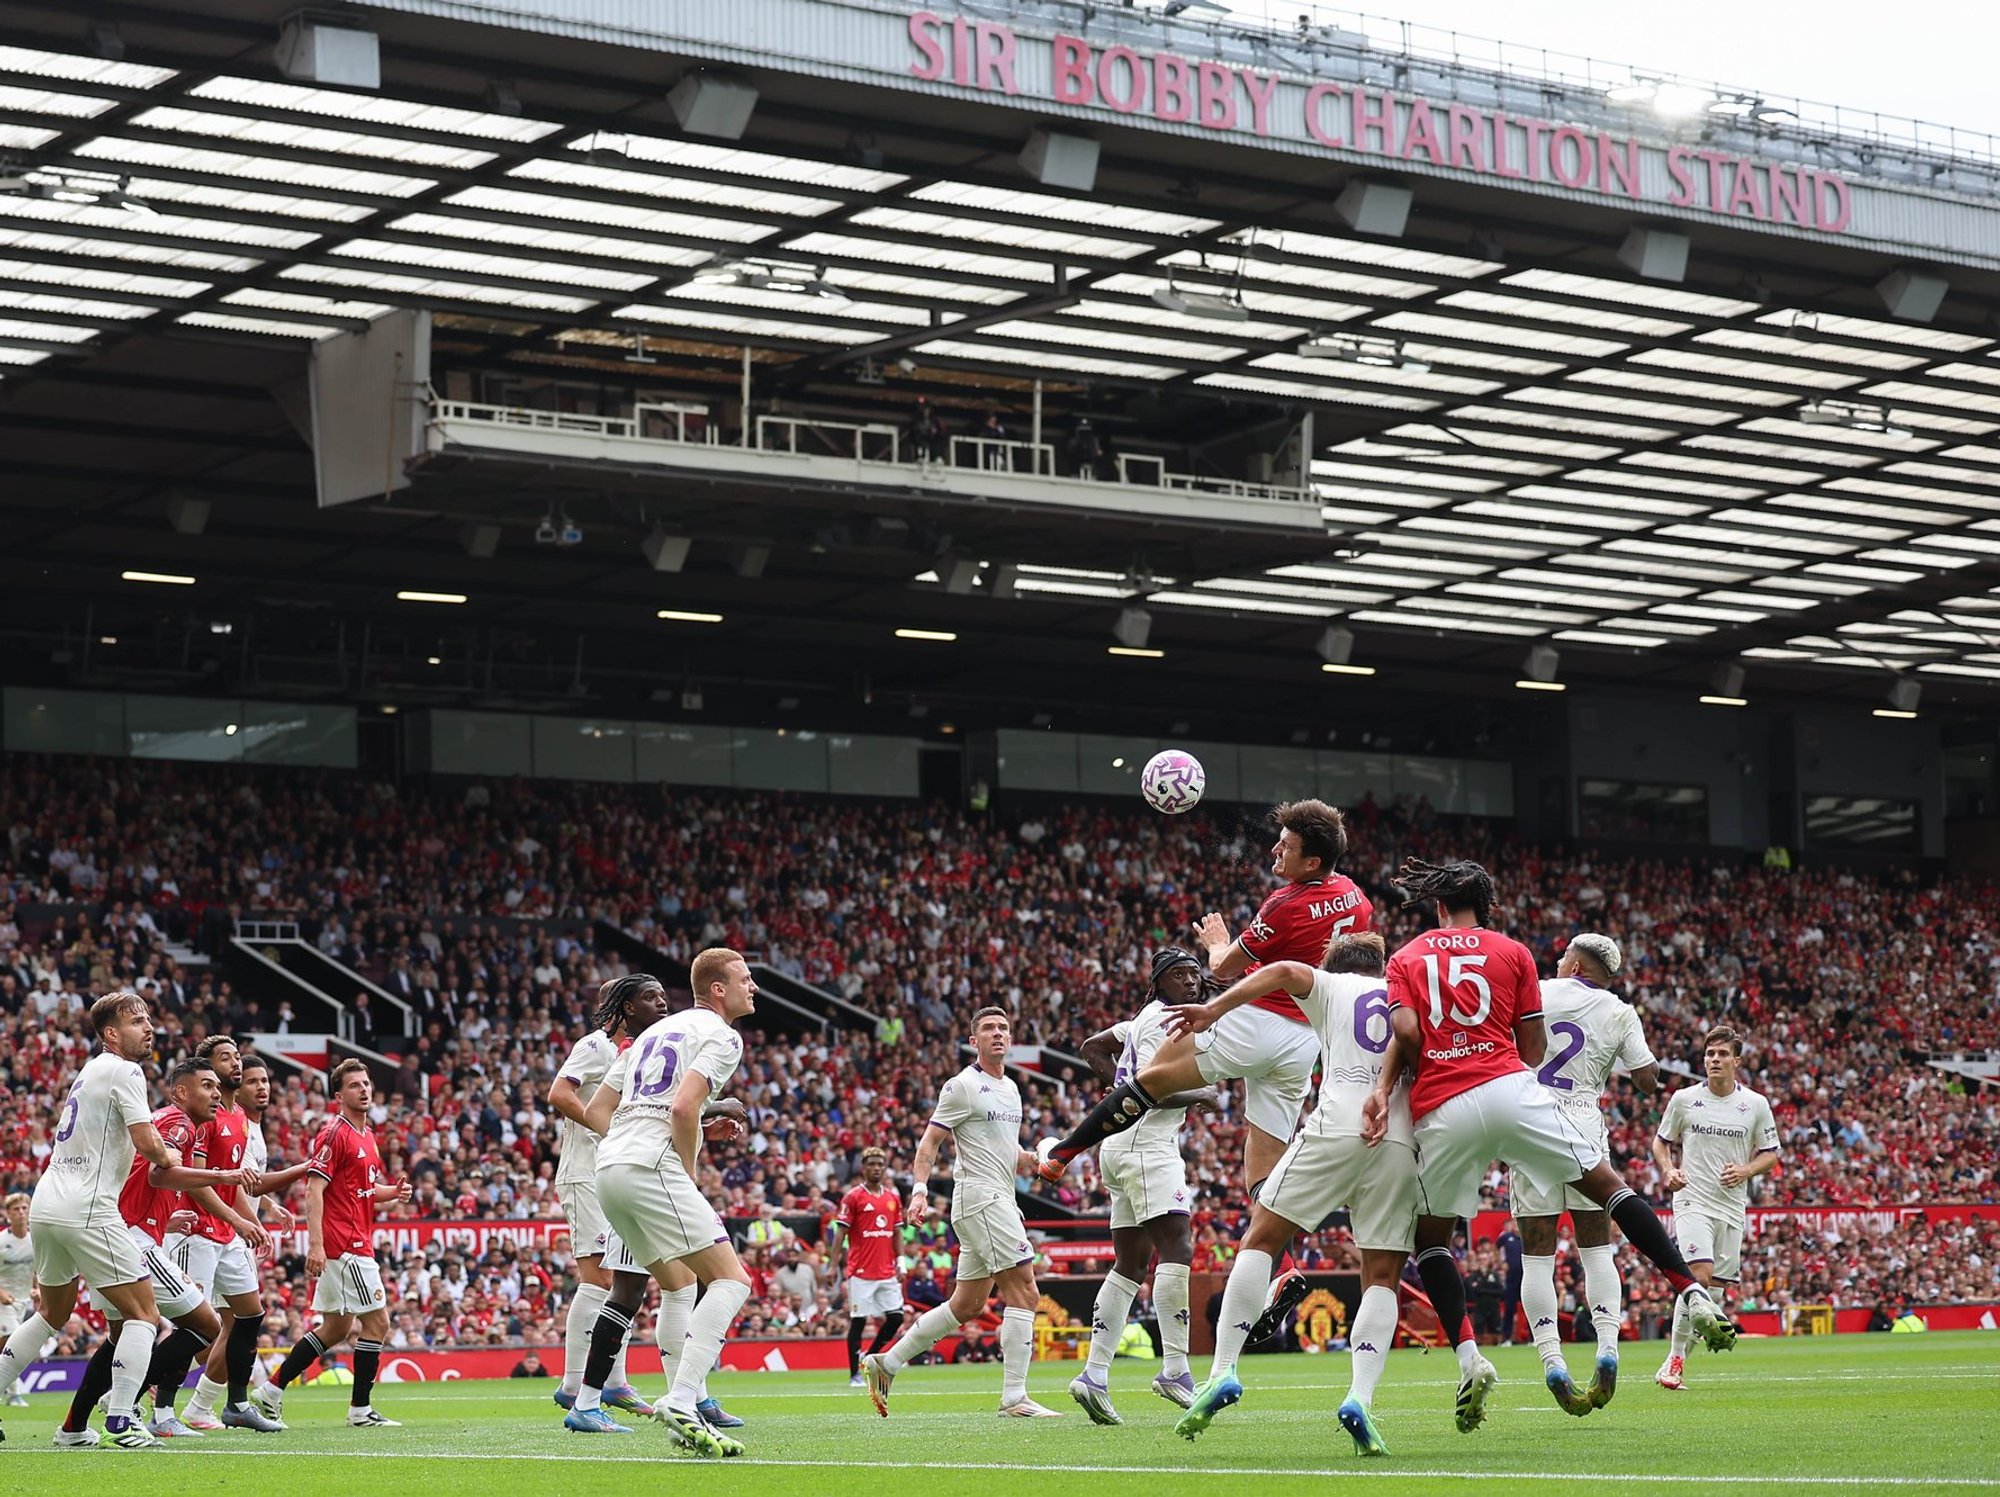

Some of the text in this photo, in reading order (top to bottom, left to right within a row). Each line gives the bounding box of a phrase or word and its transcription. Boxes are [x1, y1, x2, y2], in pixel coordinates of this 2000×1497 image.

[908, 12, 1852, 234] SIR BOBBY CHARLTON STAND
[1425, 935, 1480, 950] YORO
[1354, 988, 1394, 1054] 6
[1420, 953, 1491, 1030] 15
[631, 1032, 687, 1102] 15
[1537, 1021, 1585, 1091] 2
[57, 1080, 85, 1142] 5
[1691, 1123, 1744, 1139] Mediacom
